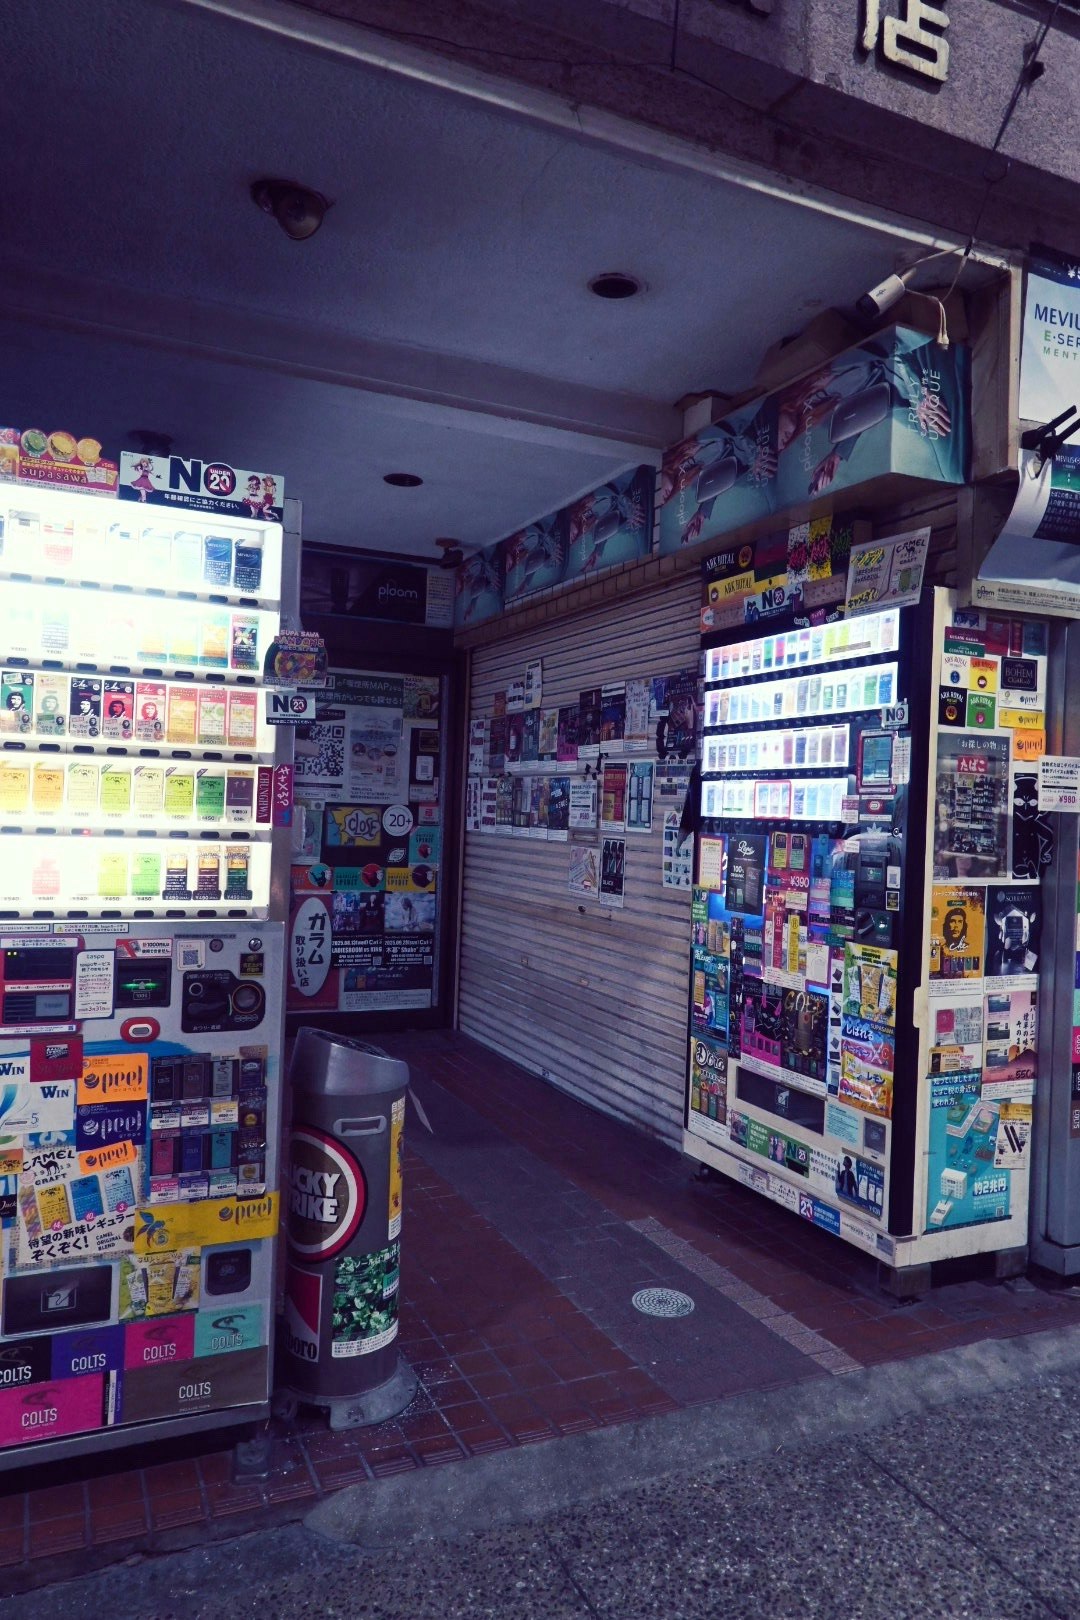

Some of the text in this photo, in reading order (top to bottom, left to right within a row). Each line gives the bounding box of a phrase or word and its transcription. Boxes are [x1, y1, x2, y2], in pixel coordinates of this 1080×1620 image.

[908, 376, 920, 433] TRULY
[928, 369, 941, 441] UNIQUE
[803, 414, 813, 472] ploom
[21, 467, 87, 484] supasawa
[209, 468, 231, 477] UNDER
[209, 473, 231, 491] 20
[896, 539, 927, 553] CAMEL
[378, 583, 418, 601] ploom
[1004, 666, 1033, 680] BOHEM
[1024, 738, 1043, 754] peel
[960, 758, 986, 772] たばこ
[258, 773, 270, 819] CHUNGHWA
[1058, 795, 1076, 804] ¥980
[348, 808, 381, 838] CLOSE
[389, 813, 412, 828] 20+
[415, 836, 434, 844] SPIRIT
[789, 876, 810, 888] ¥390
[307, 912, 327, 965] ガラム
[294, 935, 310, 988] 取り扱い店
[0, 1063, 25, 1076] WIN
[101, 1065, 143, 1094] peel
[40, 1085, 69, 1099] WIN
[31, 1113, 39, 1125] 5
[101, 1110, 142, 1140] peel
[23, 1149, 75, 1172] CAMEL
[99, 1143, 128, 1168] peel
[35, 1172, 68, 1186] CRAFT
[105, 1169, 126, 1179] CAMEL
[289, 1162, 341, 1198] UCKY
[40, 1187, 61, 1196] CAMEL
[973, 1177, 1007, 1196] 約2兆円
[235, 1196, 273, 1226] peel
[289, 1189, 339, 1223] RIKE
[28, 1212, 136, 1250] 待望の新味レギュラー
[95, 1231, 114, 1241] CAMEL
[31, 1235, 90, 1262] ぞくぞく!
[96, 1235, 122, 1246] ORIGINAL
[98, 1242, 116, 1251] BLEND
[211, 1333, 244, 1350] COLTS
[143, 1343, 177, 1361] COLTS
[71, 1353, 107, 1373] COLTS
[0, 1365, 32, 1384] COLTS
[179, 1381, 212, 1399] COLTS
[21, 1407, 58, 1428] COLTS
